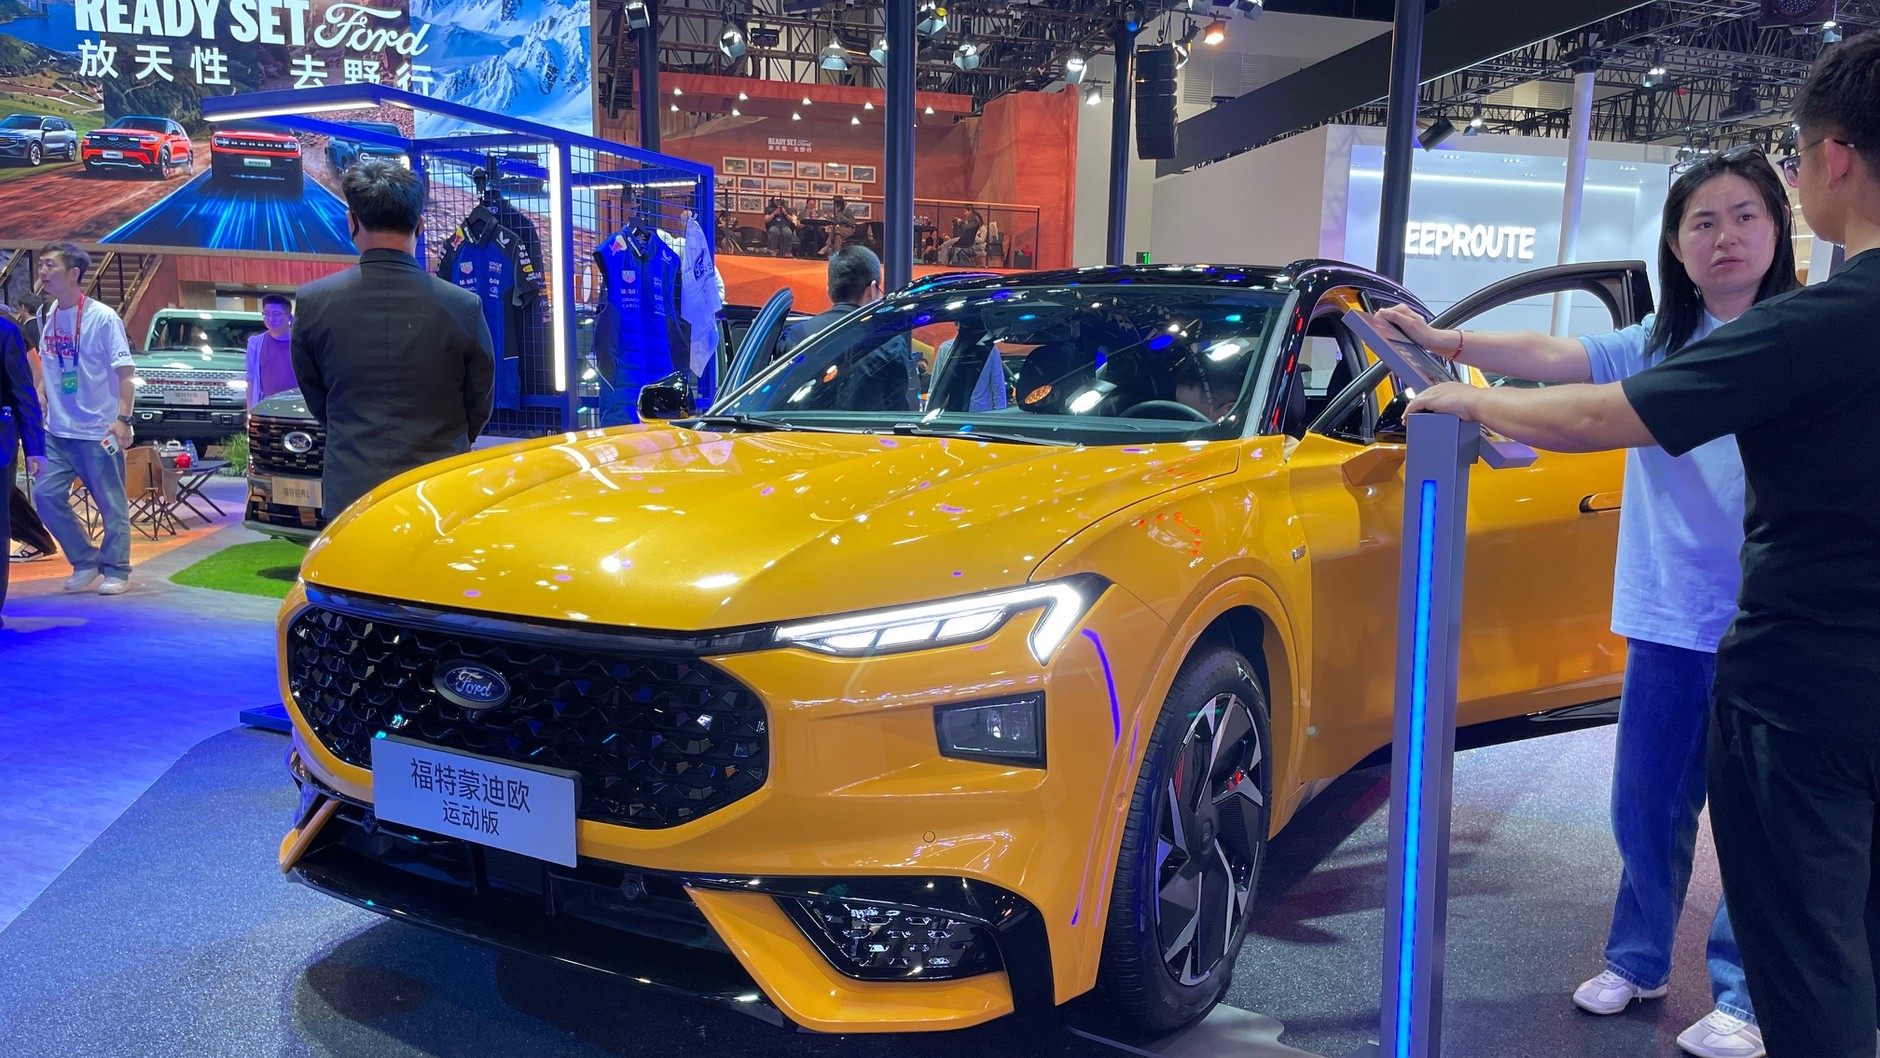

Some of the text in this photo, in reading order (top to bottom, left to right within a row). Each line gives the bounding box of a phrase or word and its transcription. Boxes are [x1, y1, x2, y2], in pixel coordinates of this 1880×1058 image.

[74, 0, 431, 57] READY SET Ford
[77, 39, 231, 86] 放天性
[1404, 221, 1536, 260] EEPROUTE
[456, 669, 493, 698] Ford
[410, 757, 531, 813] 福特蒙迪欧
[442, 799, 500, 836] 运动版
